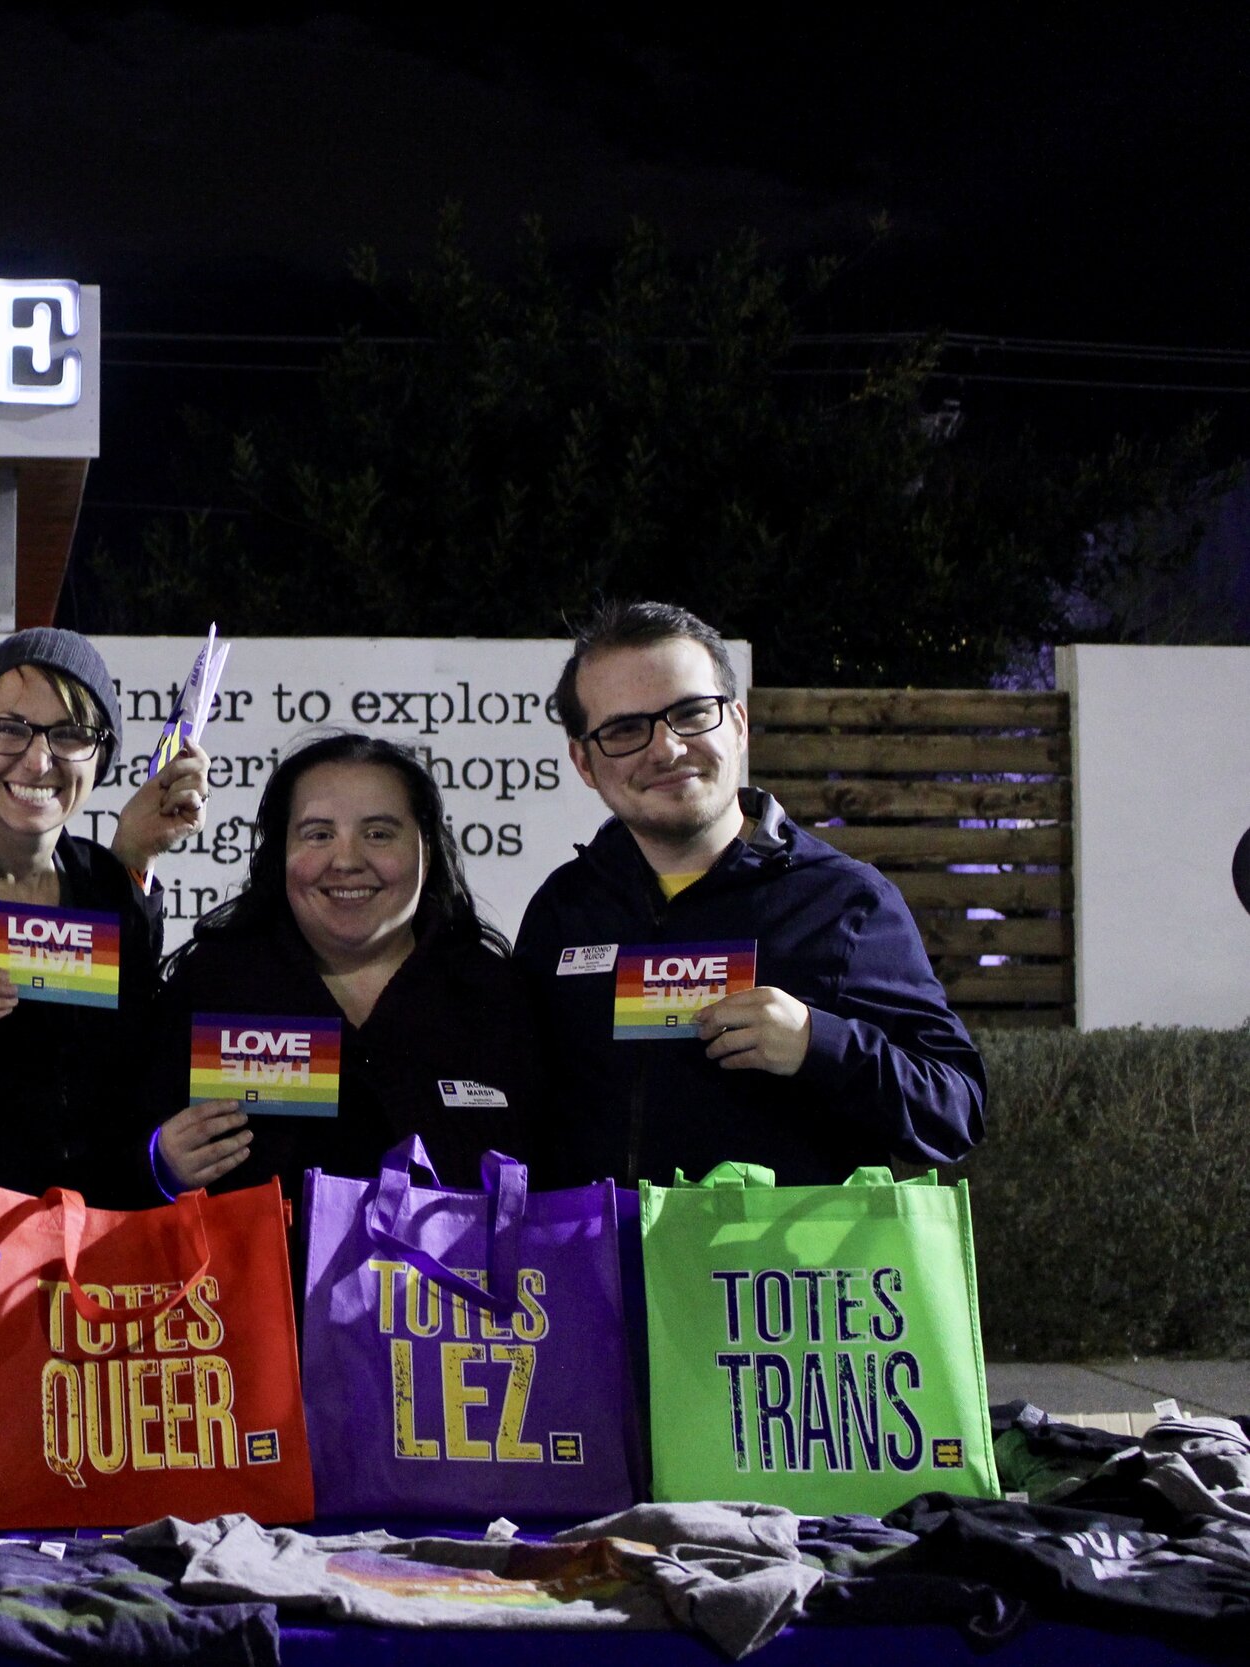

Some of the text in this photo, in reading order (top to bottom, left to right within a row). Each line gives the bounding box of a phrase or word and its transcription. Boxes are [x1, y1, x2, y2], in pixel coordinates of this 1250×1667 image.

[272, 682, 332, 723] to
[7, 916, 93, 948] LOVE
[581, 945, 612, 954] ANTONIO
[643, 956, 728, 982] LOVE
[221, 1030, 311, 1057] LOVE
[467, 1089, 495, 1097] MARSH
[37, 1275, 225, 1355] TOTES
[711, 1266, 907, 1345] TOTES
[390, 1338, 544, 1463] LEZ
[715, 1350, 924, 1473] TRANS
[41, 1355, 240, 1488] QUEER
